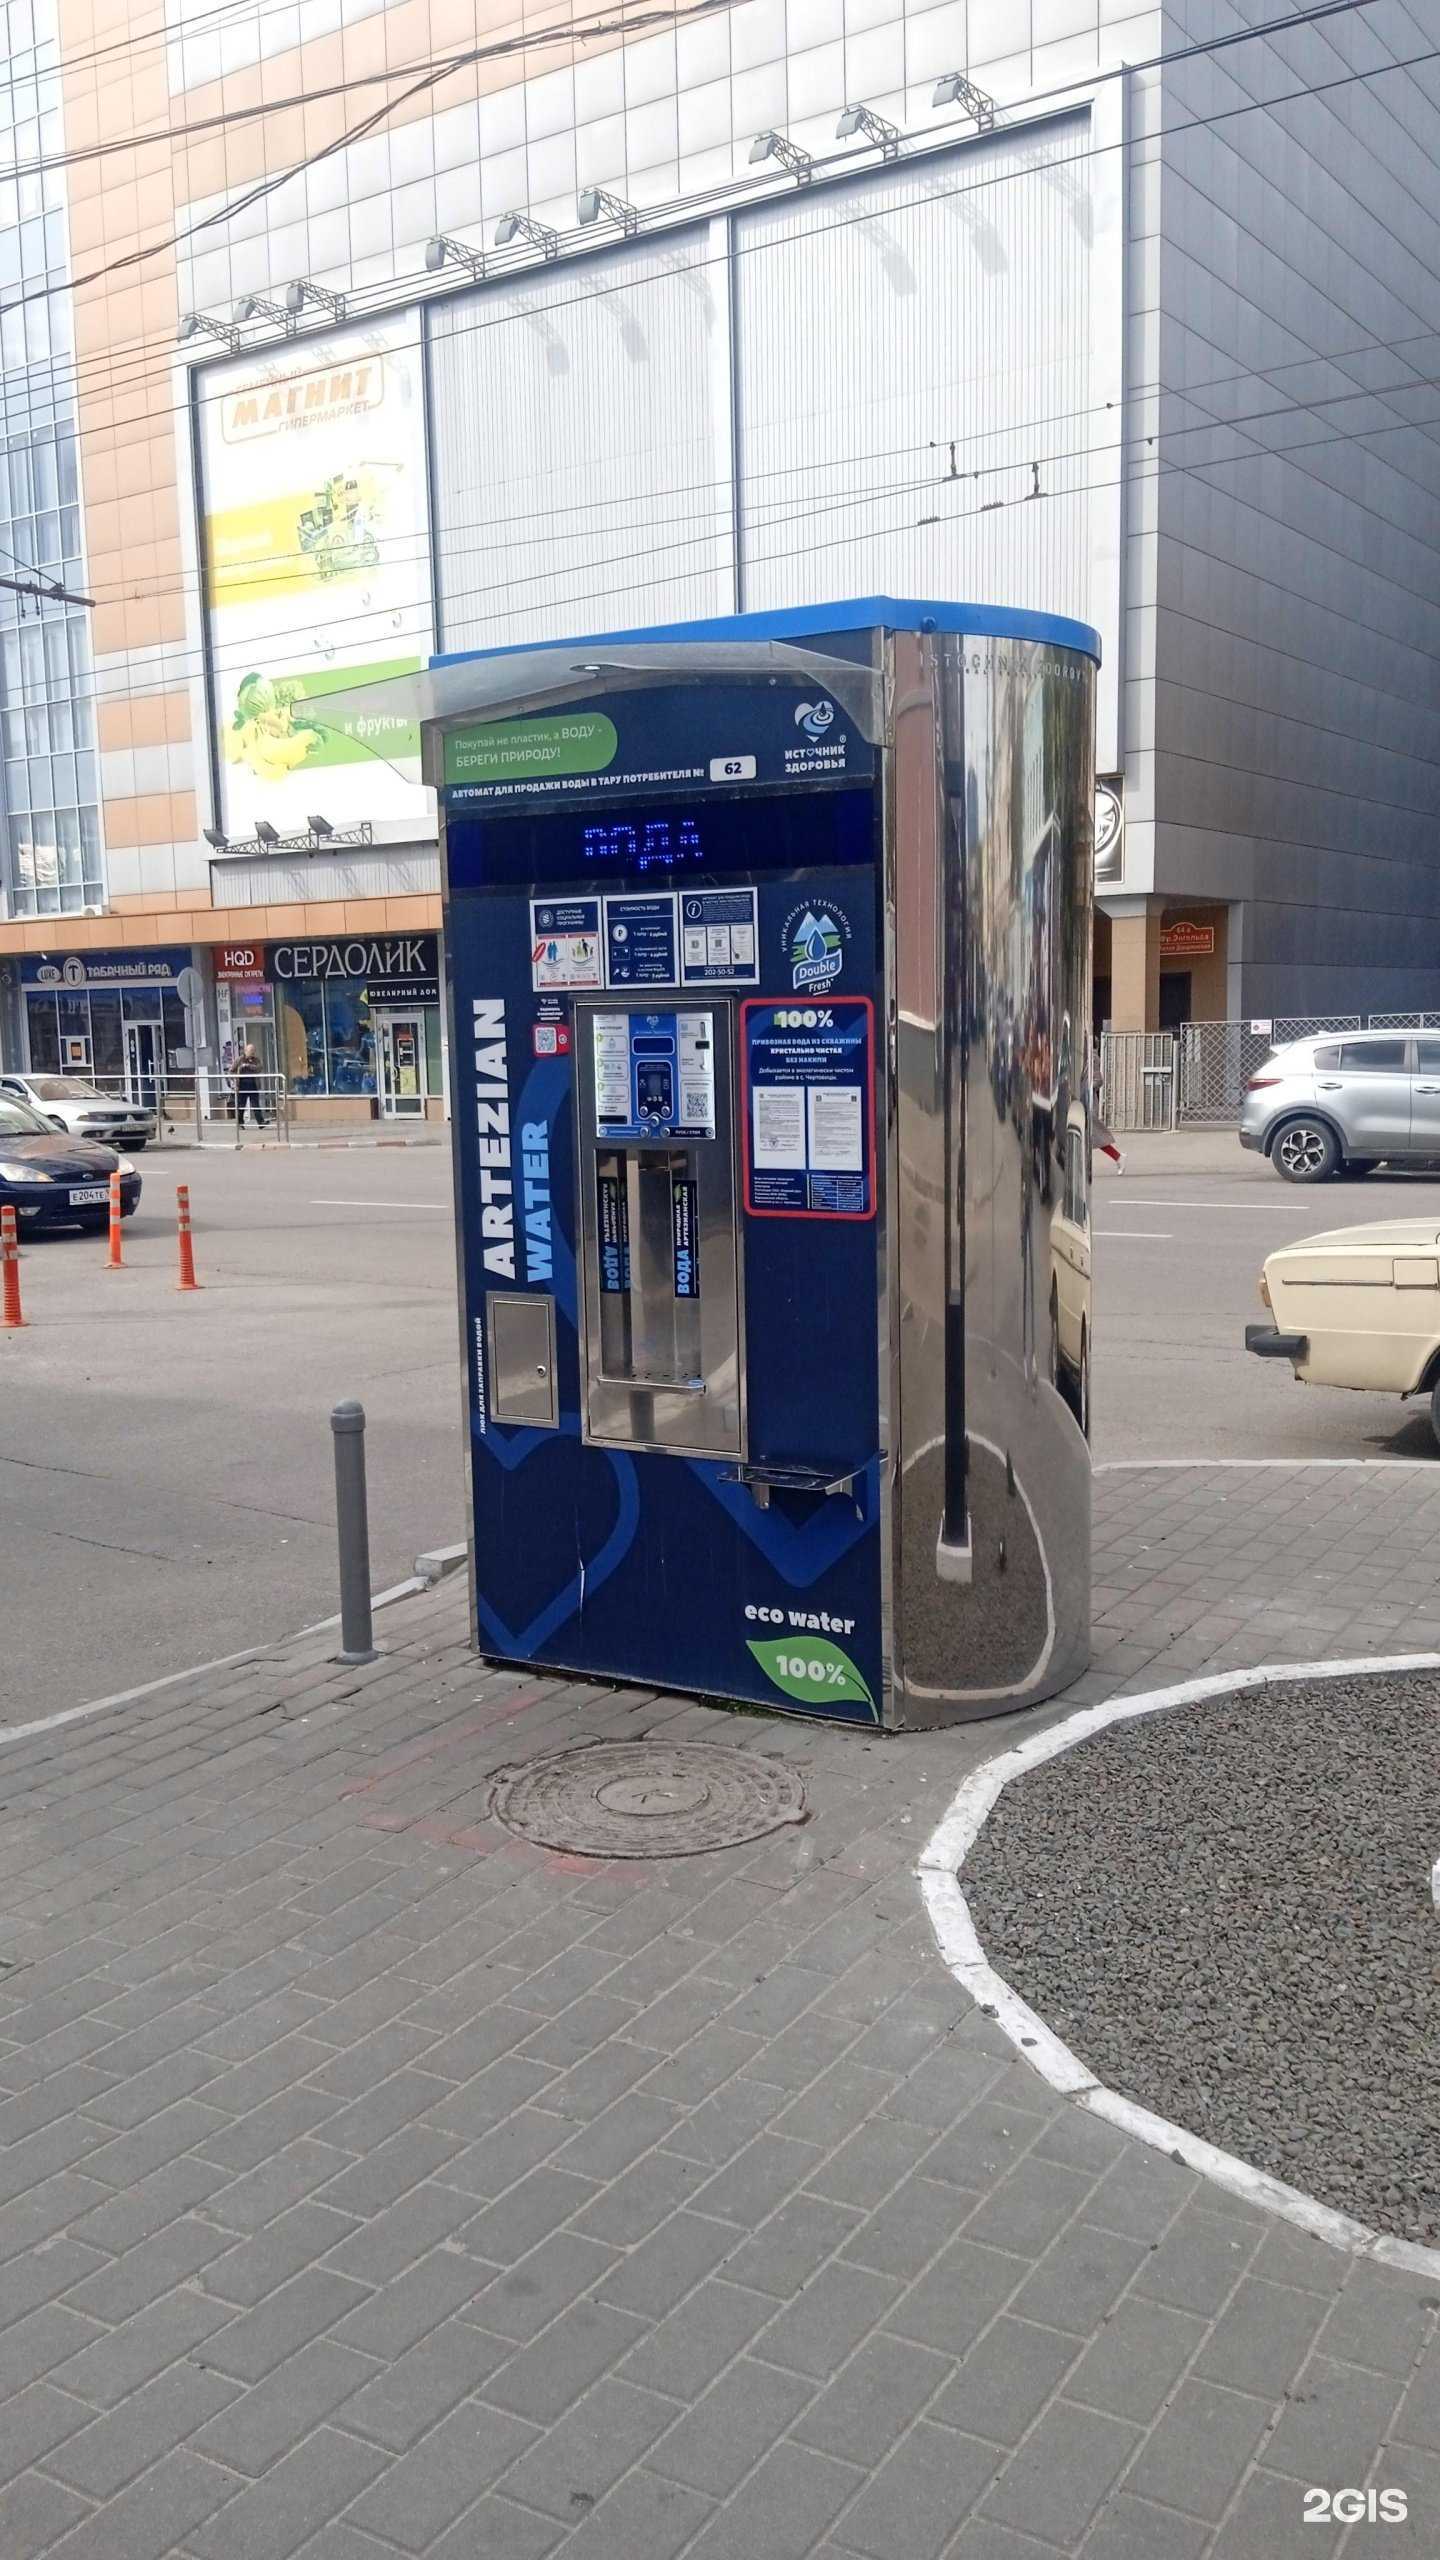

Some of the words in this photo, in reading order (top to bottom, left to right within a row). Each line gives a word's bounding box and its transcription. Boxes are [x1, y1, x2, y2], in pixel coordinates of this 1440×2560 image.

[232, 367, 372, 428] МАГНИТ
[278, 401, 369, 432] ГИПЕРМАРКЕТ
[455, 738, 495, 751] Покупай
[497, 737, 508, 747] не
[562, 725, 594, 739] ВОДУ
[456, 753, 498, 768] БЕРЕГИ
[501, 747, 561, 763] ПРИРОДУ!
[785, 759, 846, 774] ЗДОРОВЬЯ
[452, 787, 494, 799] АВТОМАТ
[494, 785, 513, 796] ДЛЯ
[514, 781, 560, 793] ПРОДАЖИ
[562, 778, 590, 789] ВОДЫ
[591, 777, 598, 786] В
[599, 776, 622, 786] ТАРУ
[623, 769, 691, 784] ПОТРЕБИТЕЛЯ
[724, 762, 742, 775] 62
[782, 900, 810, 952] УНИКАЛЬНАЯ
[813, 899, 852, 939] ТЕХНОЛОГИЯ
[87, 961, 146, 978] ТАБАЧНЫЙ
[148, 963, 171, 977] РЯД
[224, 950, 254, 966] HQD
[274, 940, 427, 980] СЕРДОЛИК
[799, 960, 836, 978] Double
[370, 988, 417, 997] ЮВЕЛИРНЫЙ
[808, 980, 831, 993] Fresh
[777, 1010, 834, 1028] 100%
[473, 998, 516, 1280] ARTEZIAN
[521, 1119, 553, 1283] WATER
[677, 1249, 692, 1294] ВОДА
[744, 1604, 784, 1624] eco
[788, 1611, 856, 1634] water
[776, 1655, 846, 1686] 100%
